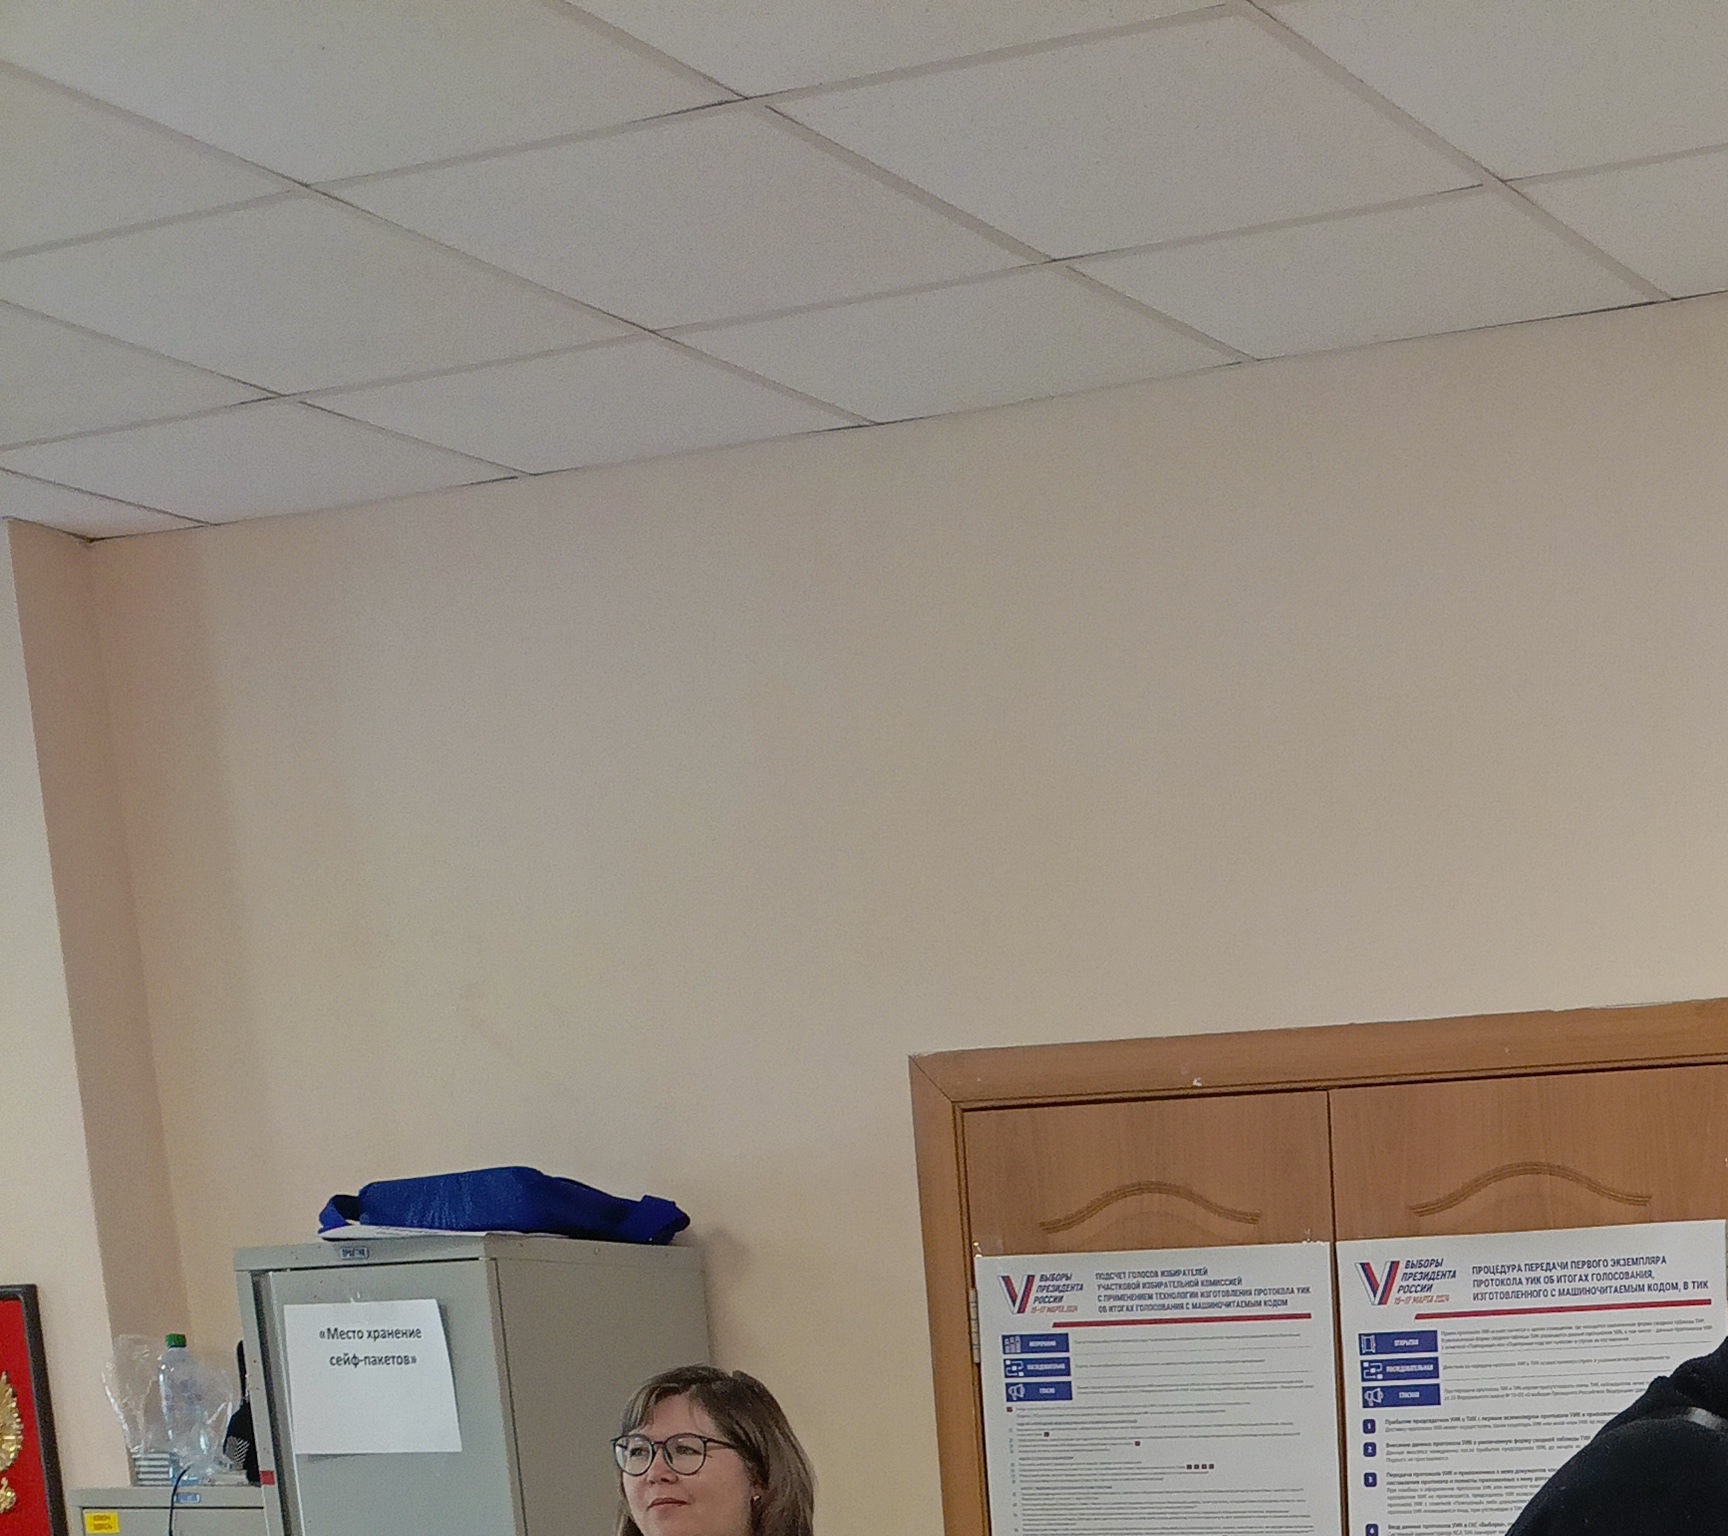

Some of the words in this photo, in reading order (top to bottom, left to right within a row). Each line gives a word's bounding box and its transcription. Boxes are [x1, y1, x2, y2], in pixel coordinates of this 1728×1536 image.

[1404, 1258, 1444, 1270] ВЫБОРЫ
[1472, 1264, 1523, 1276] ПРОЦЕДУРА
[1524, 1262, 1568, 1273] ПЕРЕДАЧИ
[1570, 1258, 1608, 1270] ПЕРВОГО
[1610, 1256, 1667, 1268] ЭКЗЕМПЛЯРА
[1039, 1273, 1072, 1282] ВЫБОРЫ
[1095, 1271, 1127, 1281] ПОДСЧЕТ
[1128, 1270, 1159, 1280] ГОЛОСОВ
[1160, 1267, 1208, 1279] ИЗБИРАТЕЛЕЙ
[1401, 1269, 1457, 1282] ПРЕЗИДЕНТА
[1472, 1277, 1524, 1288] ПРОТОКОЛА
[1525, 1275, 1541, 1285] УИК
[1544, 1274, 1554, 1284] ОБ
[1556, 1273, 1589, 1284] ИТОГАХ
[1591, 1269, 1655, 1282] ГОЛОСОВАНИЯ,
[1036, 1283, 1084, 1293] ПРЕЗИДЕНТА
[1097, 1281, 1141, 1291] УЧАСТКОВОЙ
[1142, 1279, 1200, 1290] ИЗБИРАТЕЛЬНОЙ
[1200, 1276, 1243, 1287] КОМИССИЕЙ
[1397, 1284, 1433, 1294] РОССИИ
[1473, 1288, 1549, 1301] ИЗГОТОВЛЕННОГО
[1551, 1288, 1556, 1297] С
[1558, 1283, 1645, 1297] МАШИНОЧИТАЕМЫМ
[1647, 1282, 1681, 1293] КОДОМ,
[1683, 1281, 1689, 1290] В
[1692, 1280, 1709, 1290] ТИК
[1033, 1295, 1064, 1304] РОССИИ
[1103, 1293, 1154, 1302] ПРИМЕНЕНИЕМ
[1155, 1291, 1199, 1300] ТЕХНОЛОГИИ
[1200, 1289, 1253, 1299] ИЗГОТОВЛЕНИЯ
[1253, 1287, 1294, 1296] ПРОТОКОЛА
[1098, 1305, 1108, 1313] ОБ
[1108, 1304, 1135, 1313] ИТОГАХ
[1135, 1302, 1184, 1312] ГОЛОСОВАНИЯ
[1192, 1300, 1263, 1310] МАШИНОЧИТАЕМЫМ
[1263, 1299, 1288, 1308] КОДОМ
[319, 1328, 364, 1340] «Место
[366, 1328, 422, 1342] хранение
[329, 1352, 417, 1368] сейф-пакетов»
